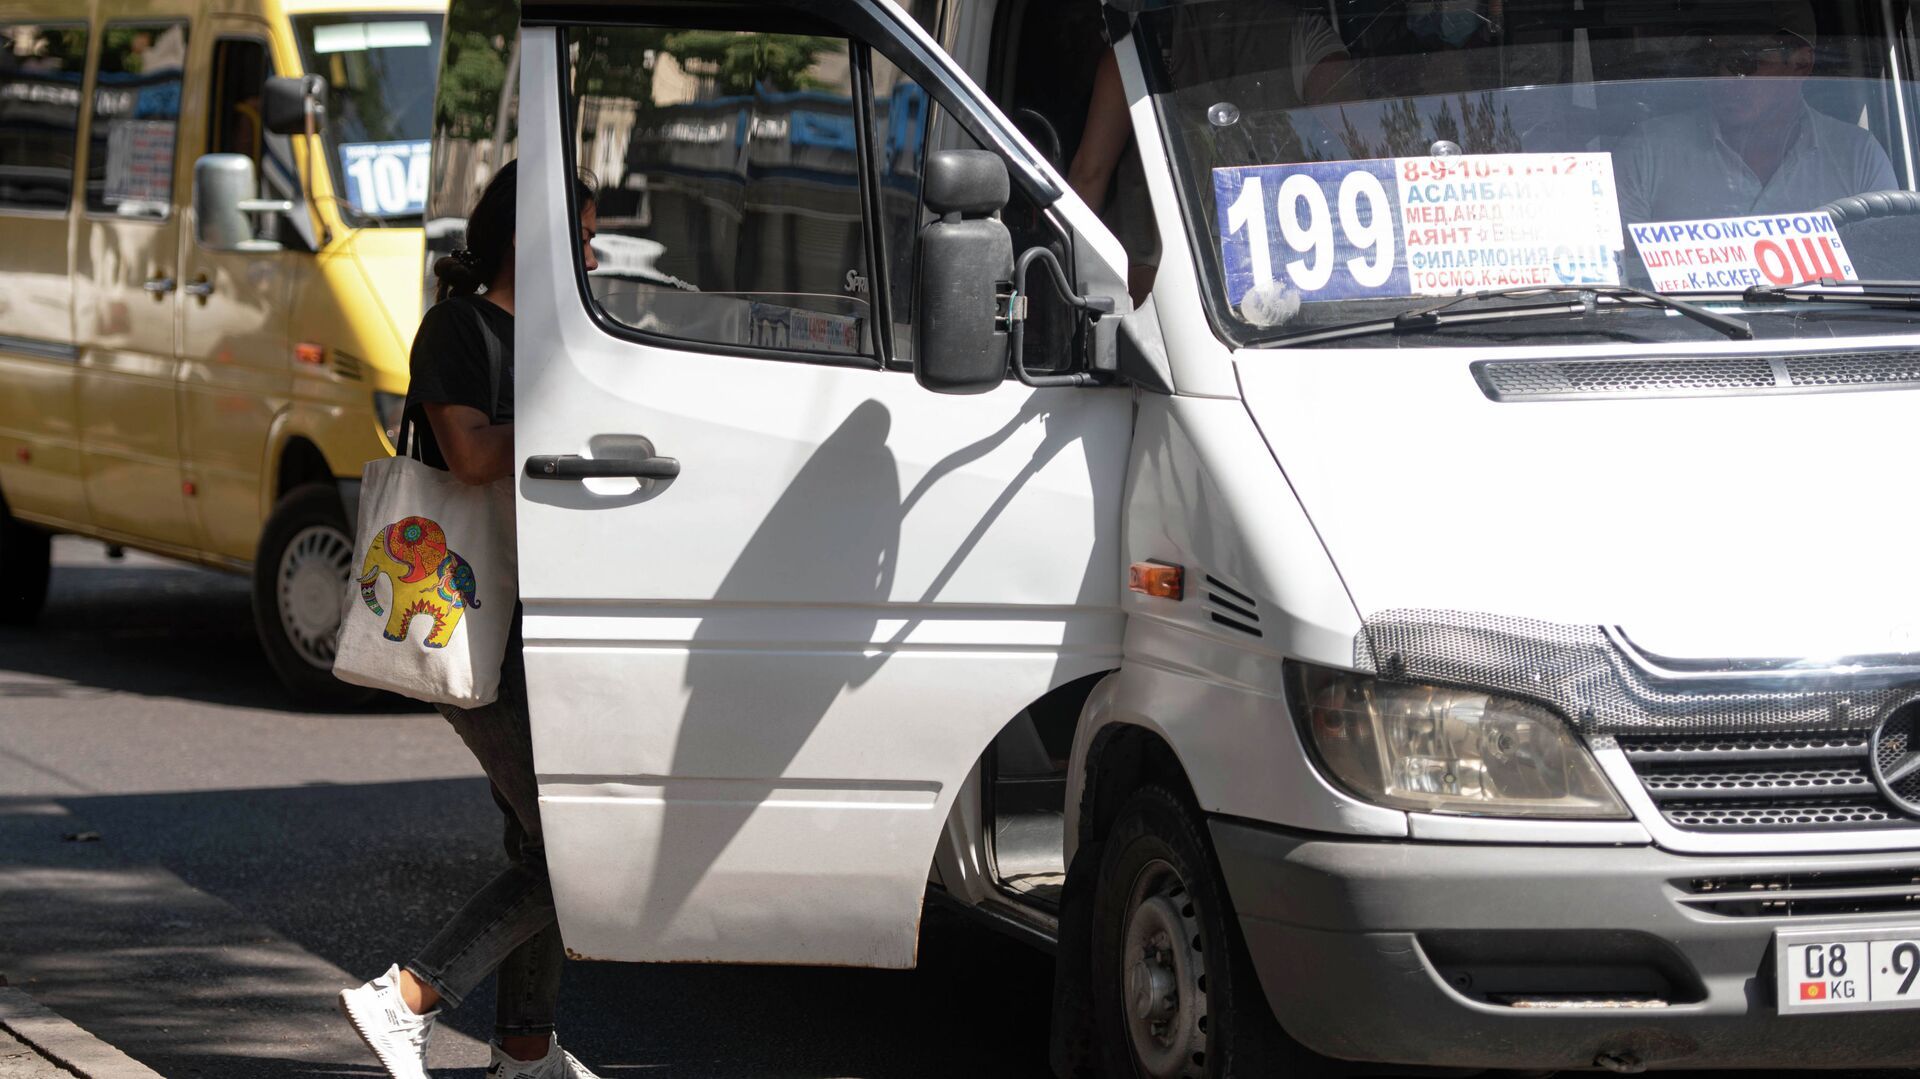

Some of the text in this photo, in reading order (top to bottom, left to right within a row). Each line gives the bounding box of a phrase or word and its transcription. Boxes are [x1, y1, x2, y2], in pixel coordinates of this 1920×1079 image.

[347, 153, 430, 213] 104
[1227, 170, 1395, 290] 199
[1633, 215, 1834, 244] КИРКОМСТРОМ
[1412, 247, 1549, 270] ФИЛАРМОНИЯ
[1643, 245, 1747, 268] ШЛАГБАУМ
[1753, 236, 1846, 286] ОШ
[1687, 268, 1761, 289] К-АСКЕР
[1804, 944, 1848, 978] 08
[1830, 980, 1856, 999] KG
